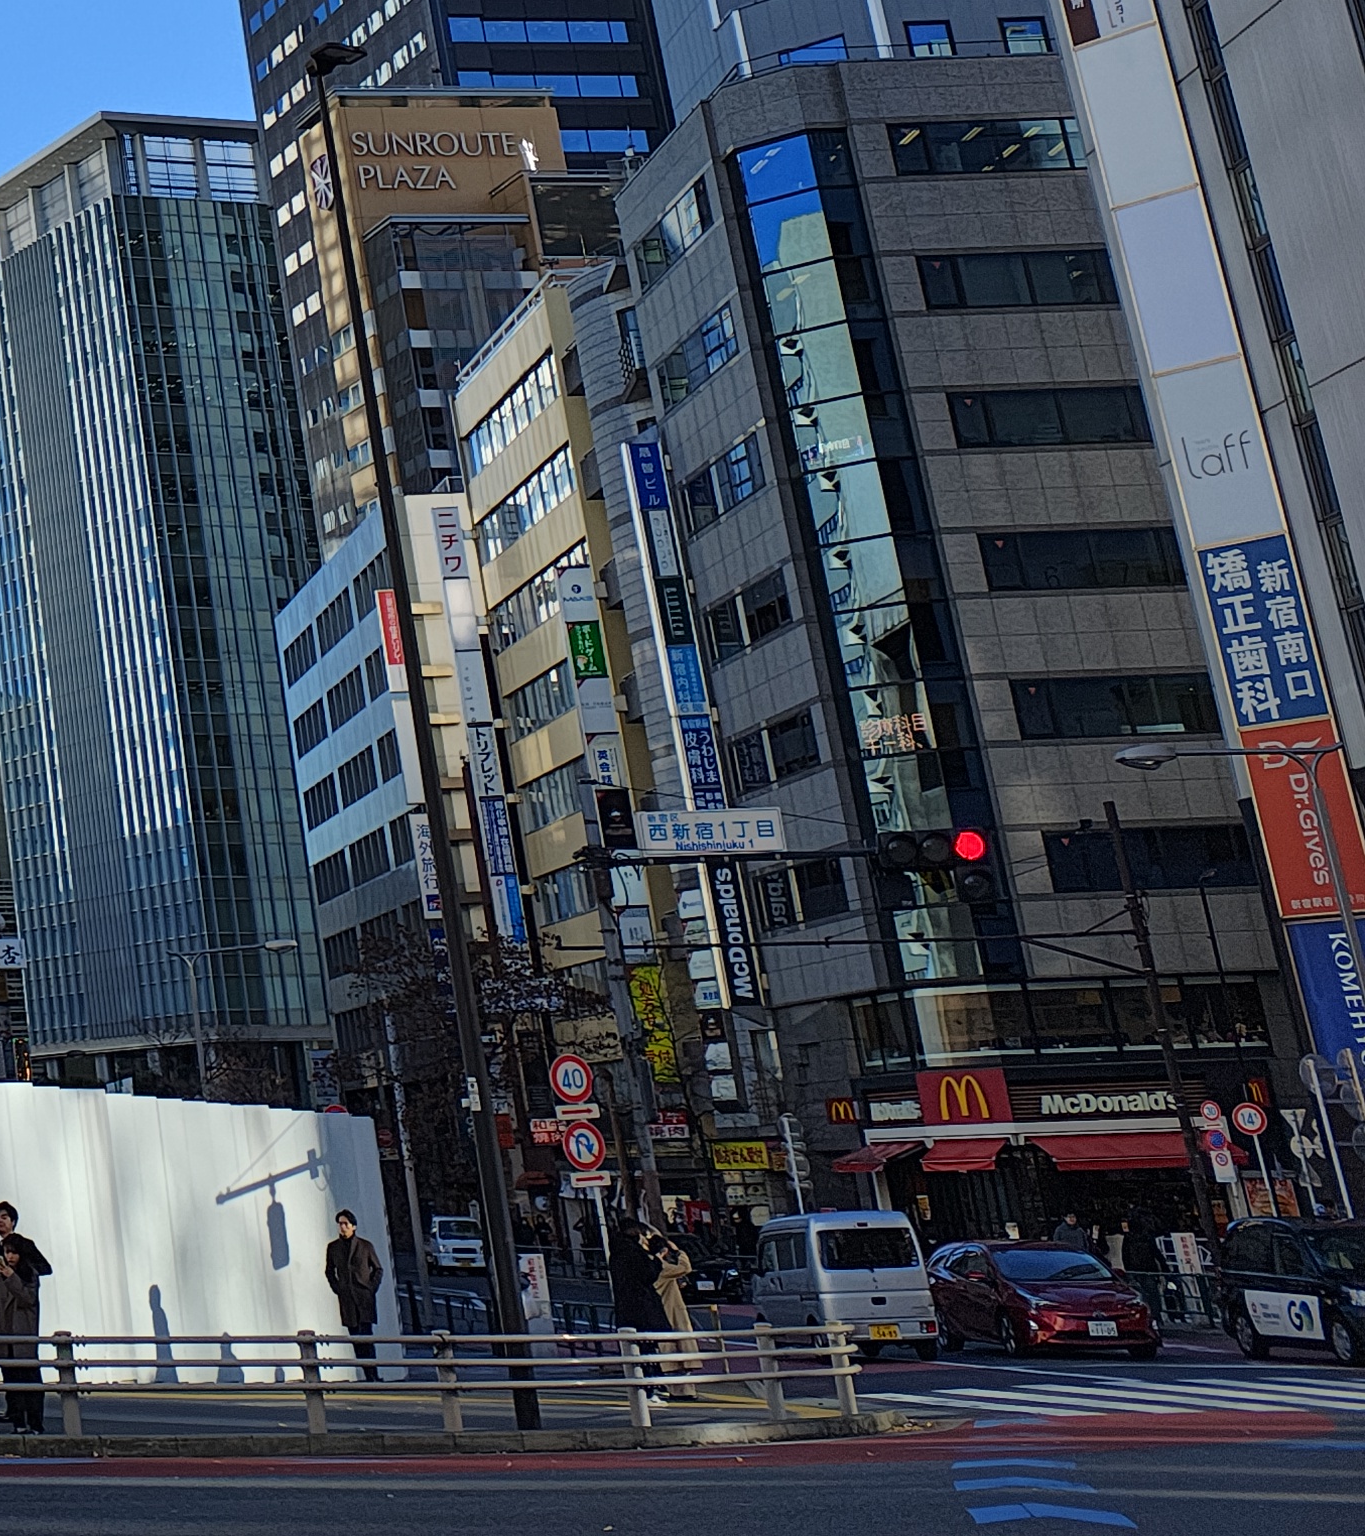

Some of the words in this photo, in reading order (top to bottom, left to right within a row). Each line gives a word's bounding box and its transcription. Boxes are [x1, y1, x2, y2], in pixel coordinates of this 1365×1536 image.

[351, 131, 518, 157] SUNROUTE
[359, 165, 457, 190] PLAZA
[438, 513, 461, 572] ニチワ
[1206, 548, 1281, 723] 矯正歯科
[1257, 559, 1316, 700] 新宿南口
[699, 731, 718, 783] うわじま
[648, 820, 775, 841] 西新宿1丁目
[675, 839, 745, 851] Nishishinjuku
[748, 839, 755, 848] 1
[715, 868, 755, 998] McDonald's
[562, 1068, 584, 1090] 40
[1041, 1091, 1178, 1114] McDonald's
